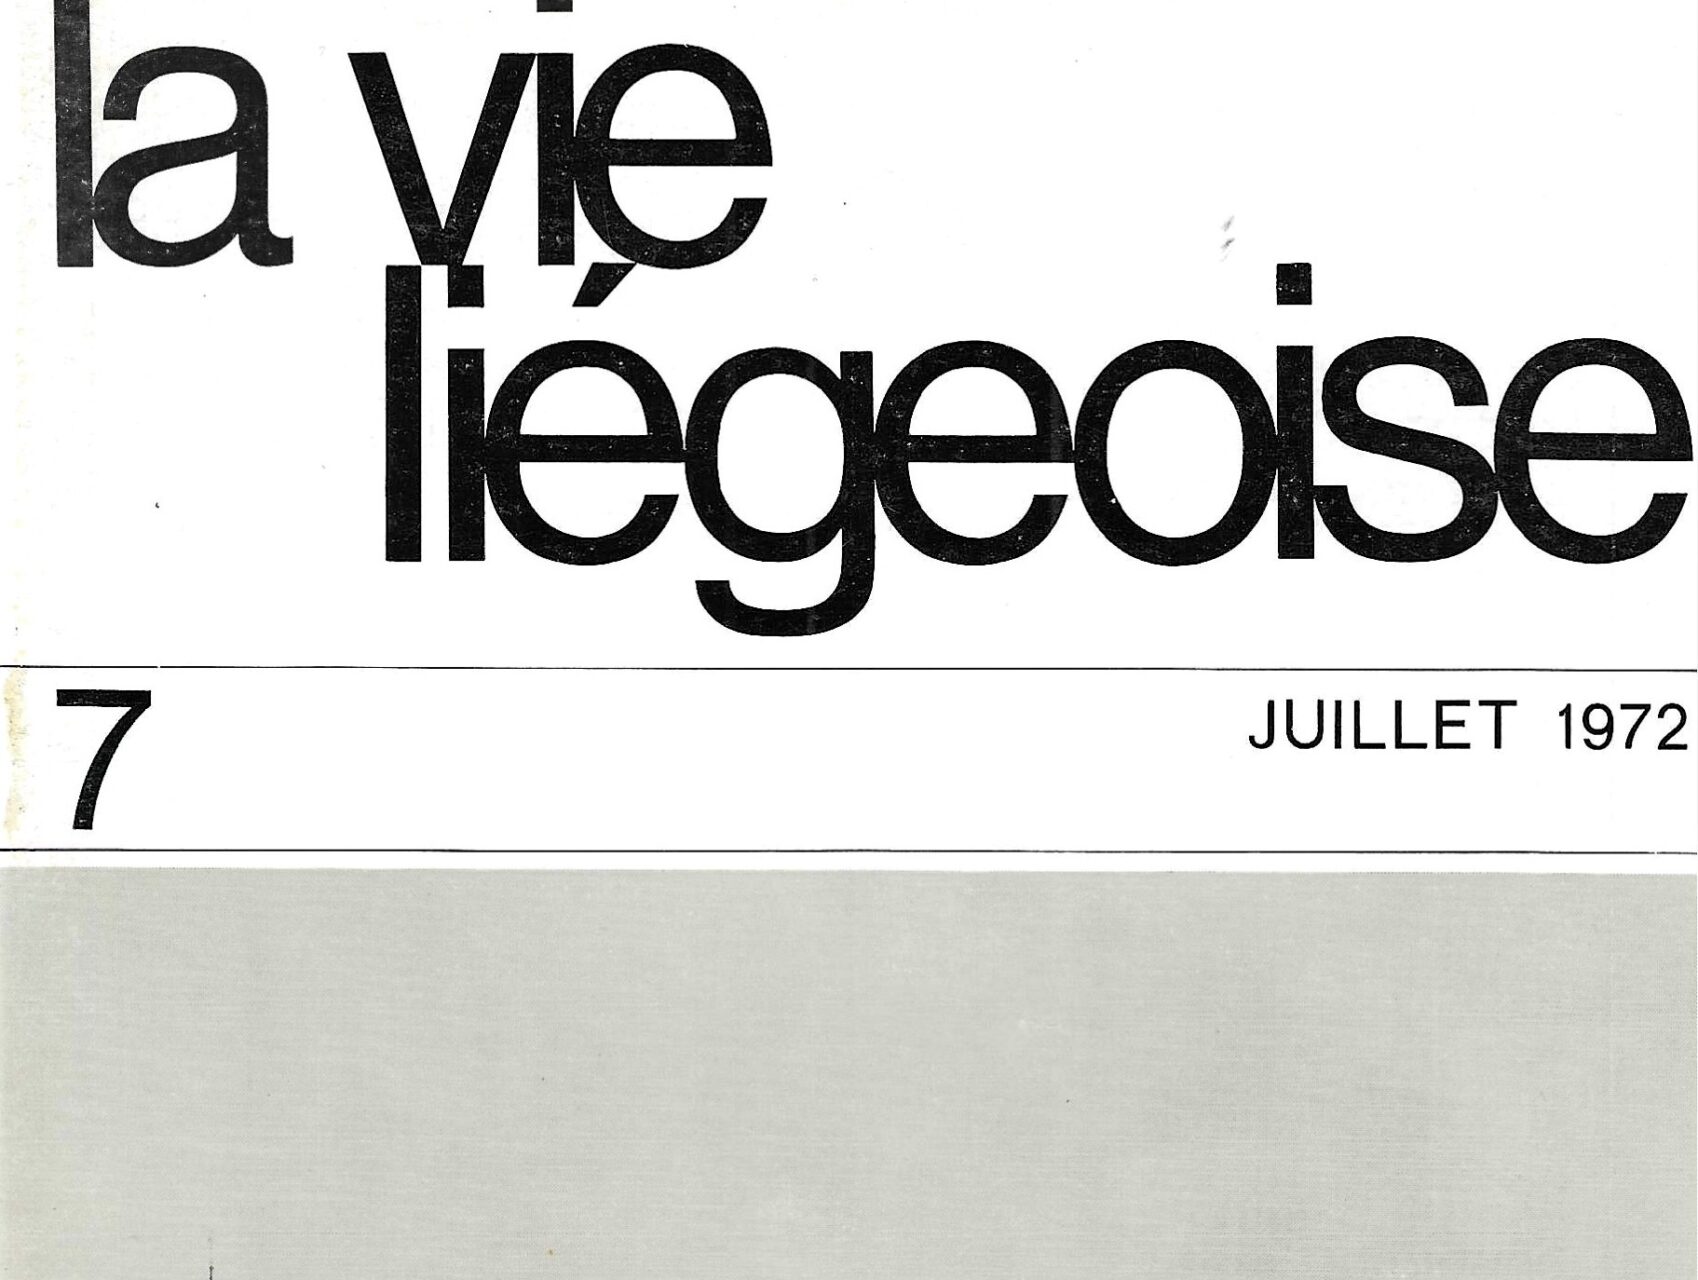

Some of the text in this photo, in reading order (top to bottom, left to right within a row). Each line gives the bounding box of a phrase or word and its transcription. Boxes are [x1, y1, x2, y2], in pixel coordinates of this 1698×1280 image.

[54, 0, 773, 270] la vie
[385, 262, 1694, 637] liégeoise
[56, 689, 152, 831] 7
[1249, 699, 1688, 750] JUILLET 1972
